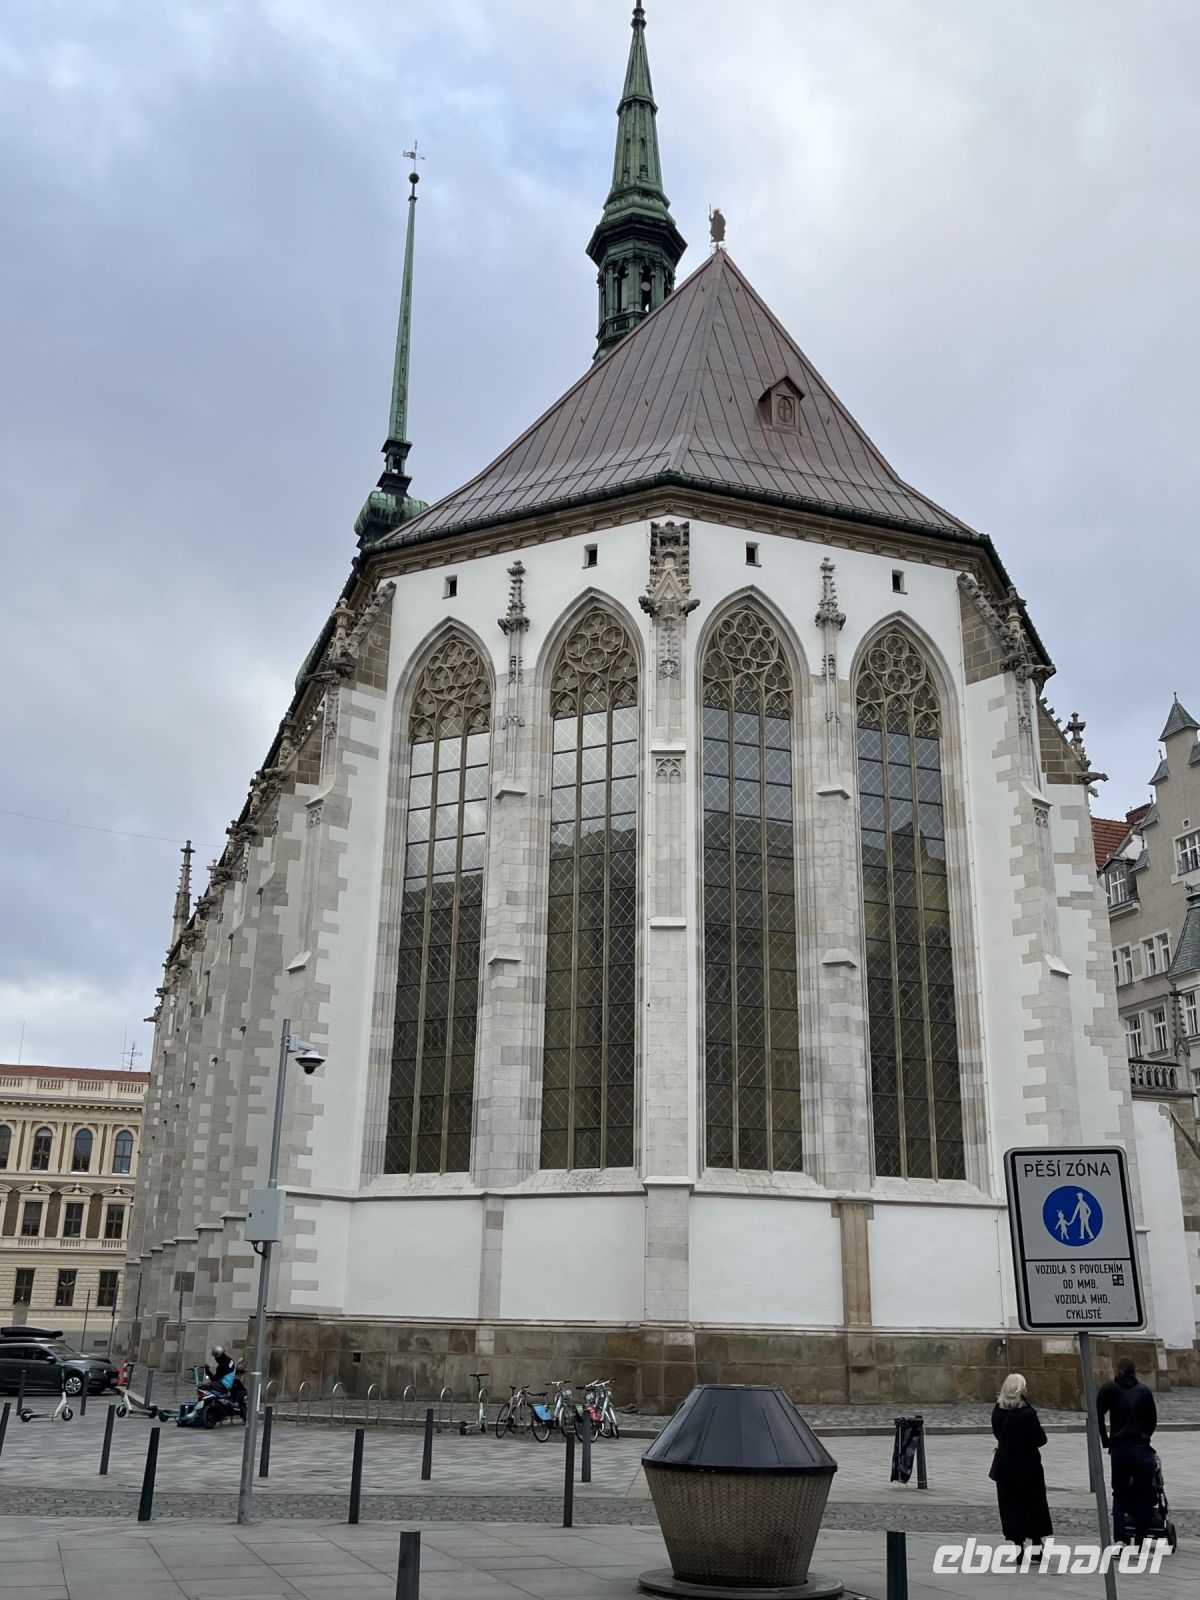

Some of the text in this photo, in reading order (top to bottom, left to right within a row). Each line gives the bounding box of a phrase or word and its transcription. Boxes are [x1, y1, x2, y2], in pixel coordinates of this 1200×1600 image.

[1024, 1159, 1111, 1177] PĚŠÍ ZÓNA
[1035, 1261, 1123, 1274] VOZIDLA S POVOLENÍM
[1063, 1280, 1073, 1289] OD
[1055, 1294, 1087, 1304] VOZIDLA
[1066, 1307, 1102, 1319] CYKLISTÉ
